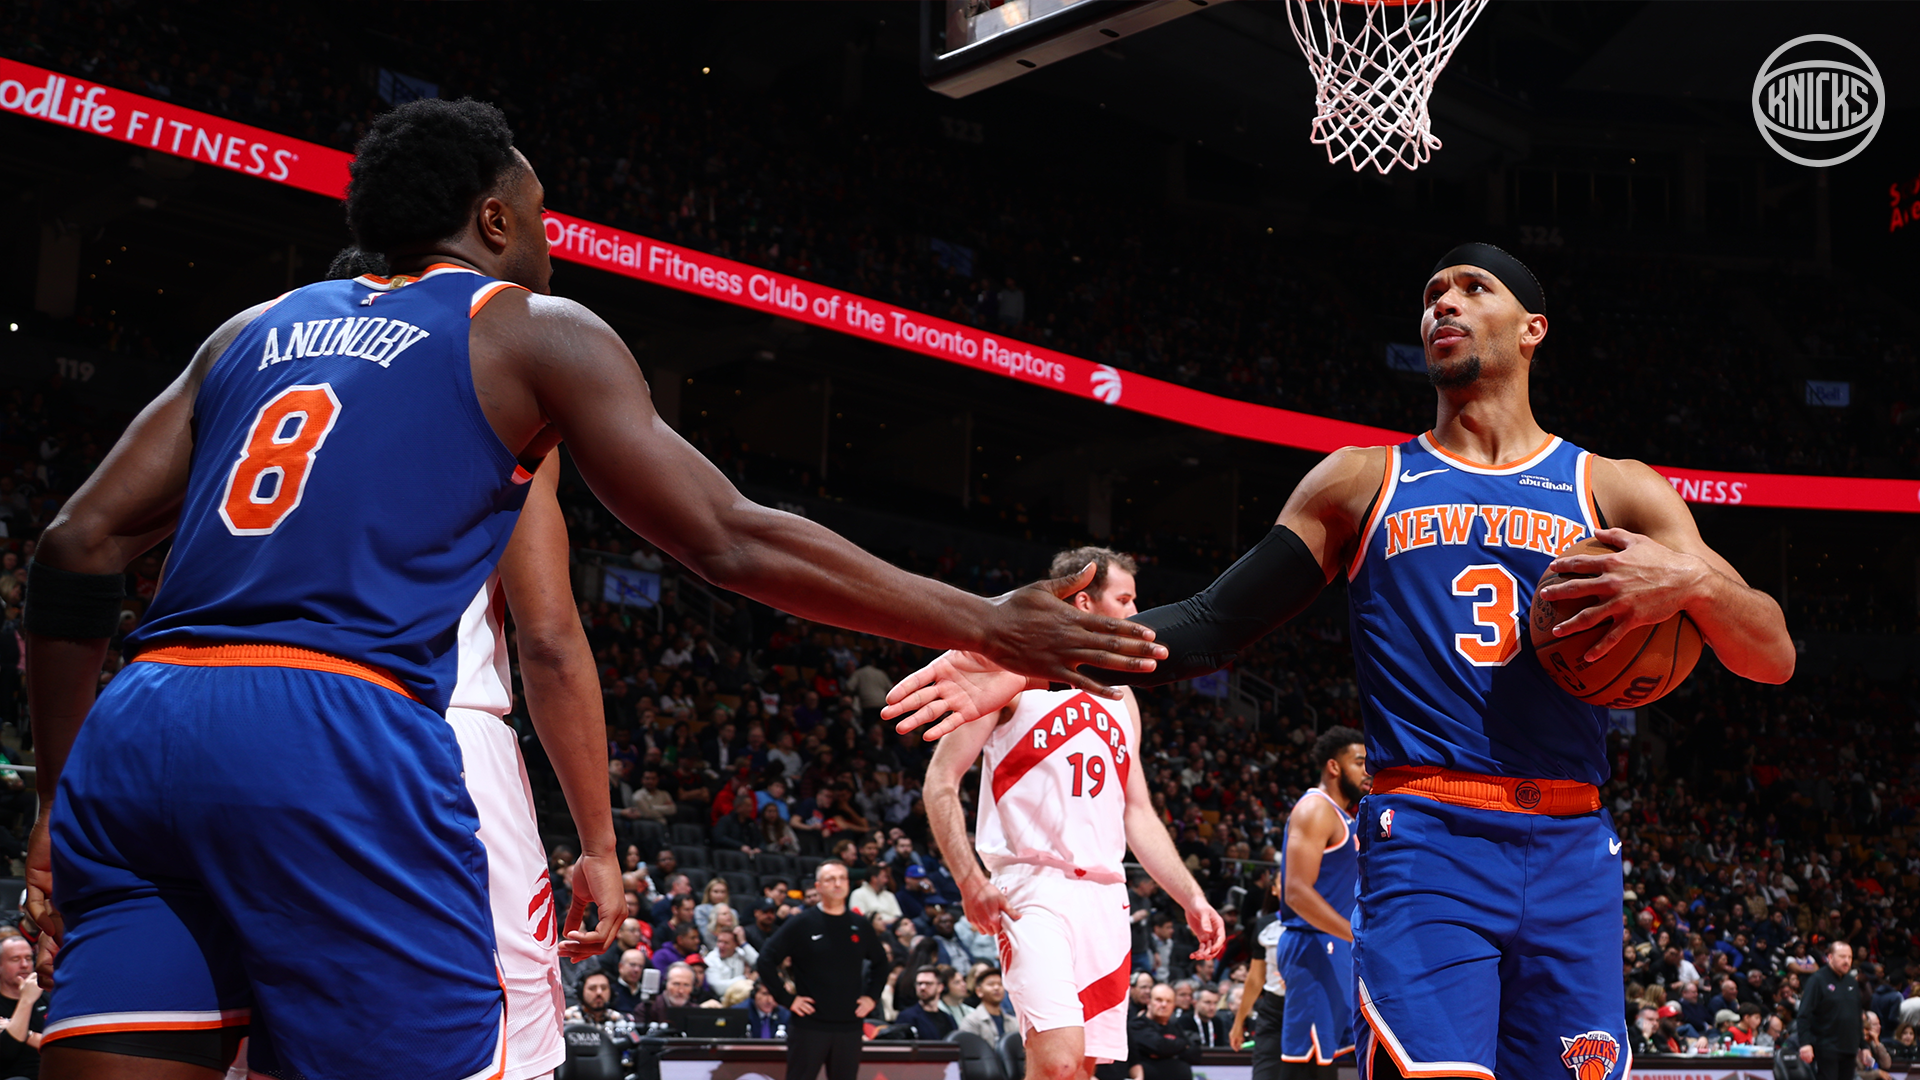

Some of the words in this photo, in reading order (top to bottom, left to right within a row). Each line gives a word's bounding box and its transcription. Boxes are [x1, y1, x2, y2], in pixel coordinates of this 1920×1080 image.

[126, 110, 292, 181] FITNESS
[543, 217, 642, 269] Official
[649, 245, 743, 296] Fitness
[749, 273, 808, 314] Club
[812, 295, 841, 320] of
[846, 300, 886, 334] the
[890, 311, 978, 359] Toronto
[982, 338, 1066, 383] Raptors
[55, 356, 96, 383] 119
[258, 317, 431, 372] ANUNOBY
[218, 382, 343, 537] 8
[1518, 478, 1541, 487] abu
[1541, 481, 1573, 492] dhabi
[1664, 476, 1743, 504] TNESS
[1384, 503, 1478, 560] NEW
[1478, 504, 1587, 559] YORK
[1451, 563, 1522, 668] 3
[1033, 701, 1127, 765] RAPTORS
[1066, 751, 1106, 799] 19
[1564, 1037, 1617, 1064] KNICKS
